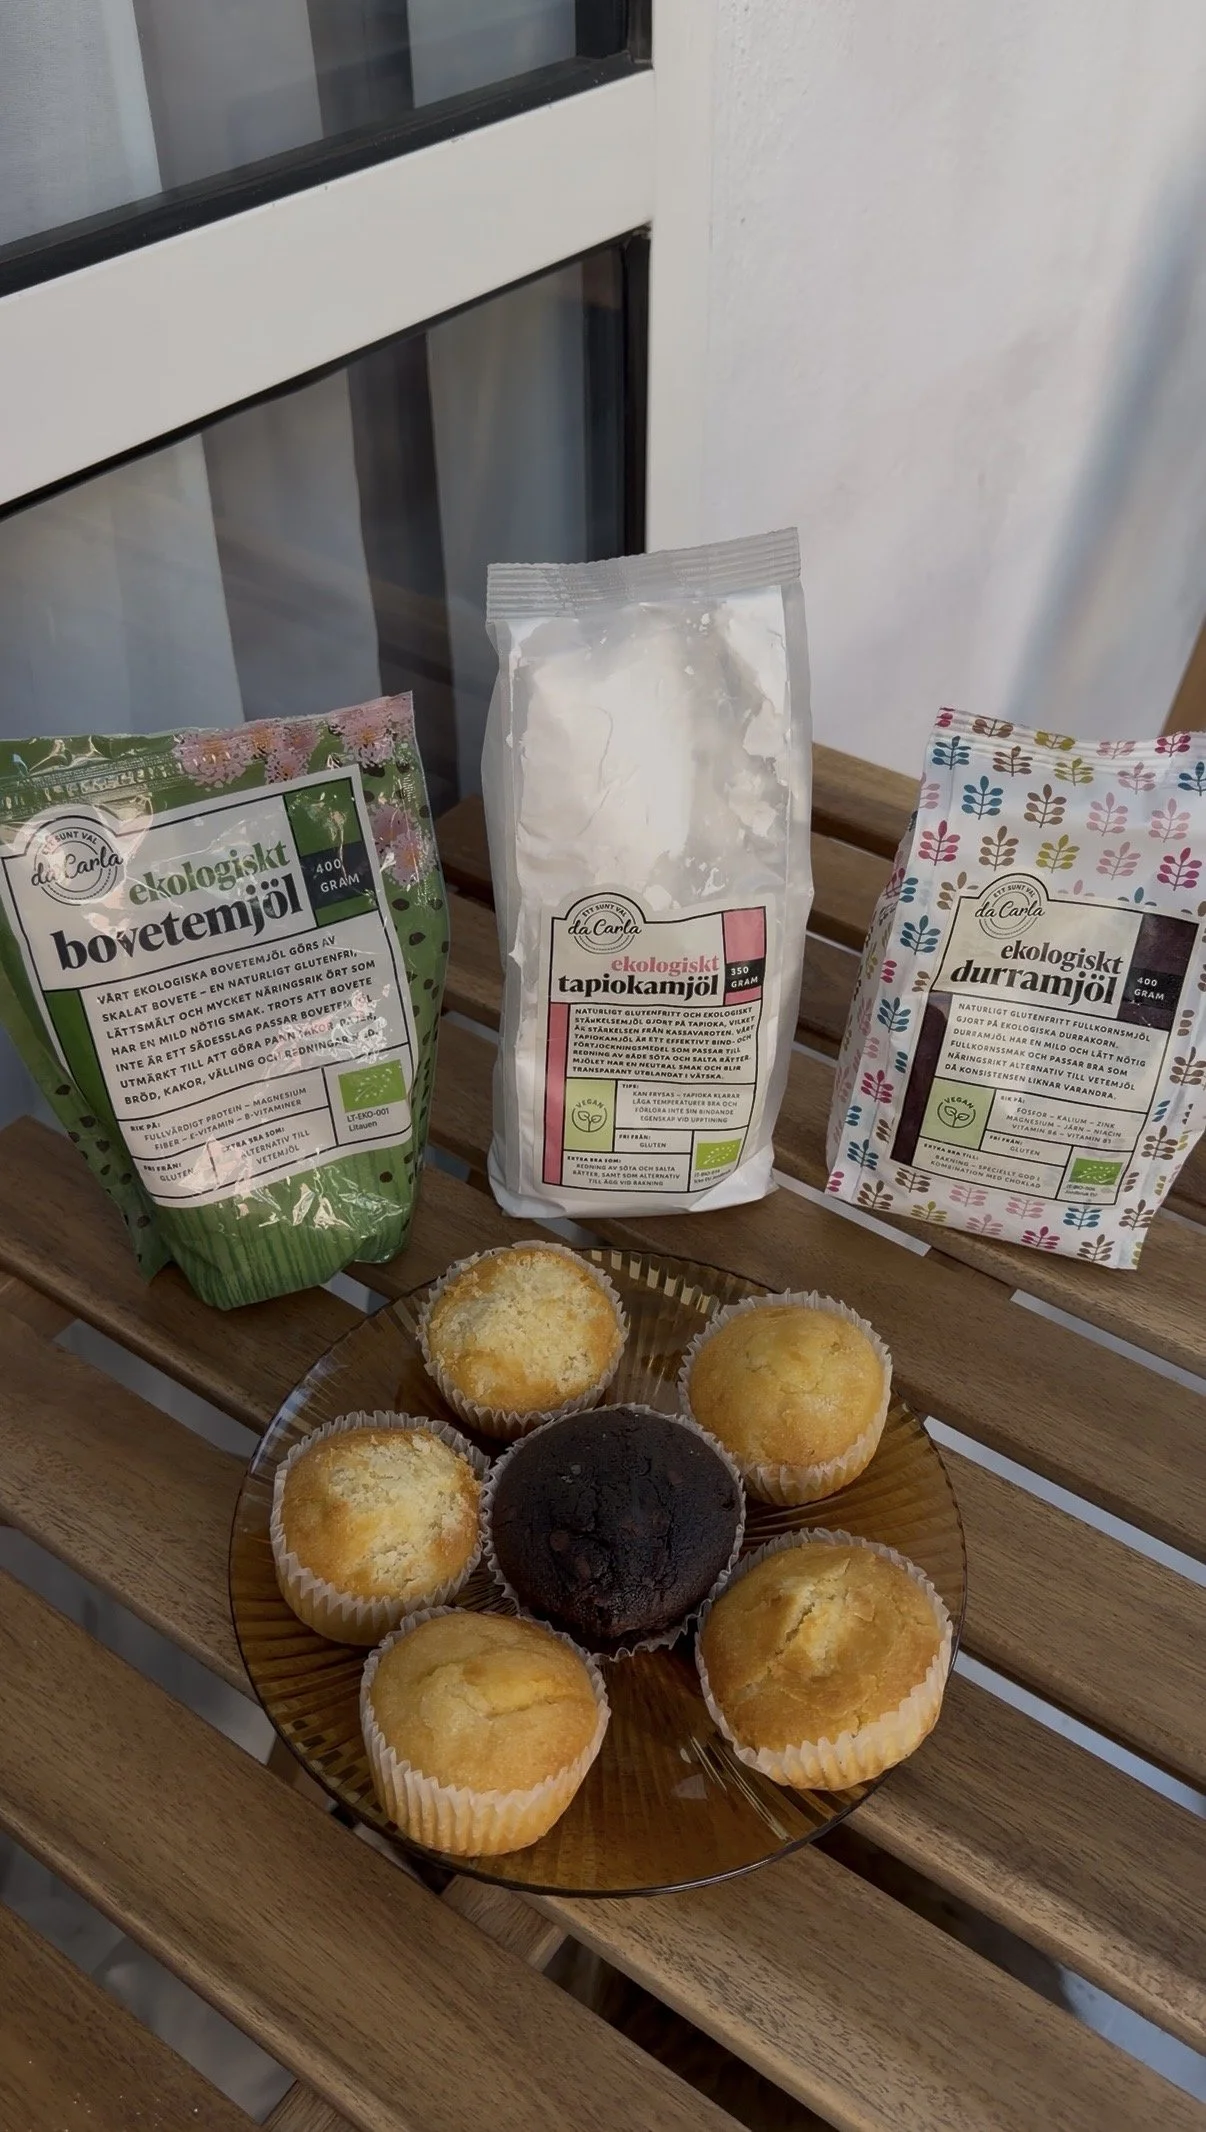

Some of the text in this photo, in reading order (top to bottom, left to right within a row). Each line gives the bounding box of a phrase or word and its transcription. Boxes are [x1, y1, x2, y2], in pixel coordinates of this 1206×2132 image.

[55, 831, 79, 841] SUNT
[82, 832, 97, 845] VAL
[31, 862, 57, 886] da
[64, 846, 124, 879] Carla
[129, 839, 291, 906] ekologiskt
[315, 858, 343, 874] 400
[319, 872, 361, 893] GRAM
[993, 888, 1005, 898] ETT
[1026, 888, 1036, 898] VAL
[582, 908, 594, 917] ETT
[616, 906, 627, 917] VAL
[975, 900, 1045, 918] da Carla
[50, 873, 304, 971] bovetemjöl
[568, 918, 642, 936] da Carla
[611, 955, 720, 976] ekologiskt
[1000, 939, 1125, 975] ekologiskt
[97, 936, 335, 1004] VÅRT EKOLOGISKA BOVETEMJÖL GÖRS AV
[730, 966, 749, 976] 350
[558, 973, 719, 1001] tapiokamjöl
[730, 976, 759, 988] GRAM
[950, 959, 1118, 1006] durramjöl
[1136, 976, 1158, 988] 400
[102, 1004, 147, 1022] SKALAT
[152, 991, 197, 1010] BOVETE
[210, 982, 224, 993] EN
[228, 965, 290, 988] NATURLIGT
[106, 960, 375, 1039] LÄTTSMÄLT OCH MYCKET NÄRINGSRIK ÖRT SOM
[1134, 988, 1165, 1001] GRAM
[111, 1044, 136, 1056] HAR
[140, 1039, 155, 1050] EN
[159, 1030, 187, 1045] MILD
[190, 1017, 226, 1034] NÖTIG
[267, 995, 303, 1011] TROTS
[306, 989, 326, 1001] ATT
[330, 977, 372, 994] BOVETE
[703, 1007, 752, 1018] EKOLOGISKT
[729, 1016, 755, 1026] VILKET
[588, 1026, 639, 1034] STÄRKELSEN
[736, 1024, 754, 1034] VÅRT
[957, 1016, 984, 1025] GJORT
[1001, 1022, 1056, 1036] EKOLOGISKA
[959, 1004, 1150, 1042] NATURLIGT GLUTENFRITT FULLKORNSMJÖL
[116, 1014, 298, 1072] INTE ÄR ETT SÄDESSLAG PASSAR
[574, 1041, 669, 1052] FÖRTJOCKNINGSMEDEL
[575, 1033, 633, 1042] TAPIOKAMJÖL
[737, 1034, 752, 1044] OCH
[954, 1028, 1006, 1041] DURRAMJÖL
[1009, 1036, 1027, 1044] HAR
[1044, 1042, 1066, 1051] MILD
[1069, 1046, 1088, 1055] OCH
[1091, 1050, 1114, 1060] LÄTT
[1116, 1056, 1146, 1067] NÖTIG
[120, 1041, 262, 1088] UTMÄRKT TILL ATT GÖRA
[639, 1062, 676, 1070] NEUTRAL
[951, 1040, 1127, 1076] FULLKORNSSMAK OCH PASSAR BRA SOM
[208, 1059, 254, 1080] VÄLLING
[573, 1066, 632, 1074] TRANSPARANT
[634, 1070, 683, 1078] UTBLANDAT
[948, 1052, 1135, 1091] NÄRINGSRIKT ALTERNATIV TILL VETEMJÖL
[959, 1066, 1026, 1082] KONSISTENSEN
[1028, 1077, 1061, 1089] LIKNAR
[575, 1099, 604, 1108] VEGAN
[944, 1097, 975, 1109] VEGAN
[144, 1119, 203, 1141] FULLVÄRDIGT
[206, 1104, 242, 1122] PROTEIN
[253, 1088, 306, 1106] MAGNESIUM
[154, 1139, 180, 1150] FIBER
[190, 1118, 234, 1140] E-VITAMIN
[244, 1099, 302, 1120] B-VITAMINER
[347, 1108, 390, 1123] LT-EKO-001
[348, 1121, 378, 1132] Litauen
[256, 1145, 300, 1164] VETEMJÖL
